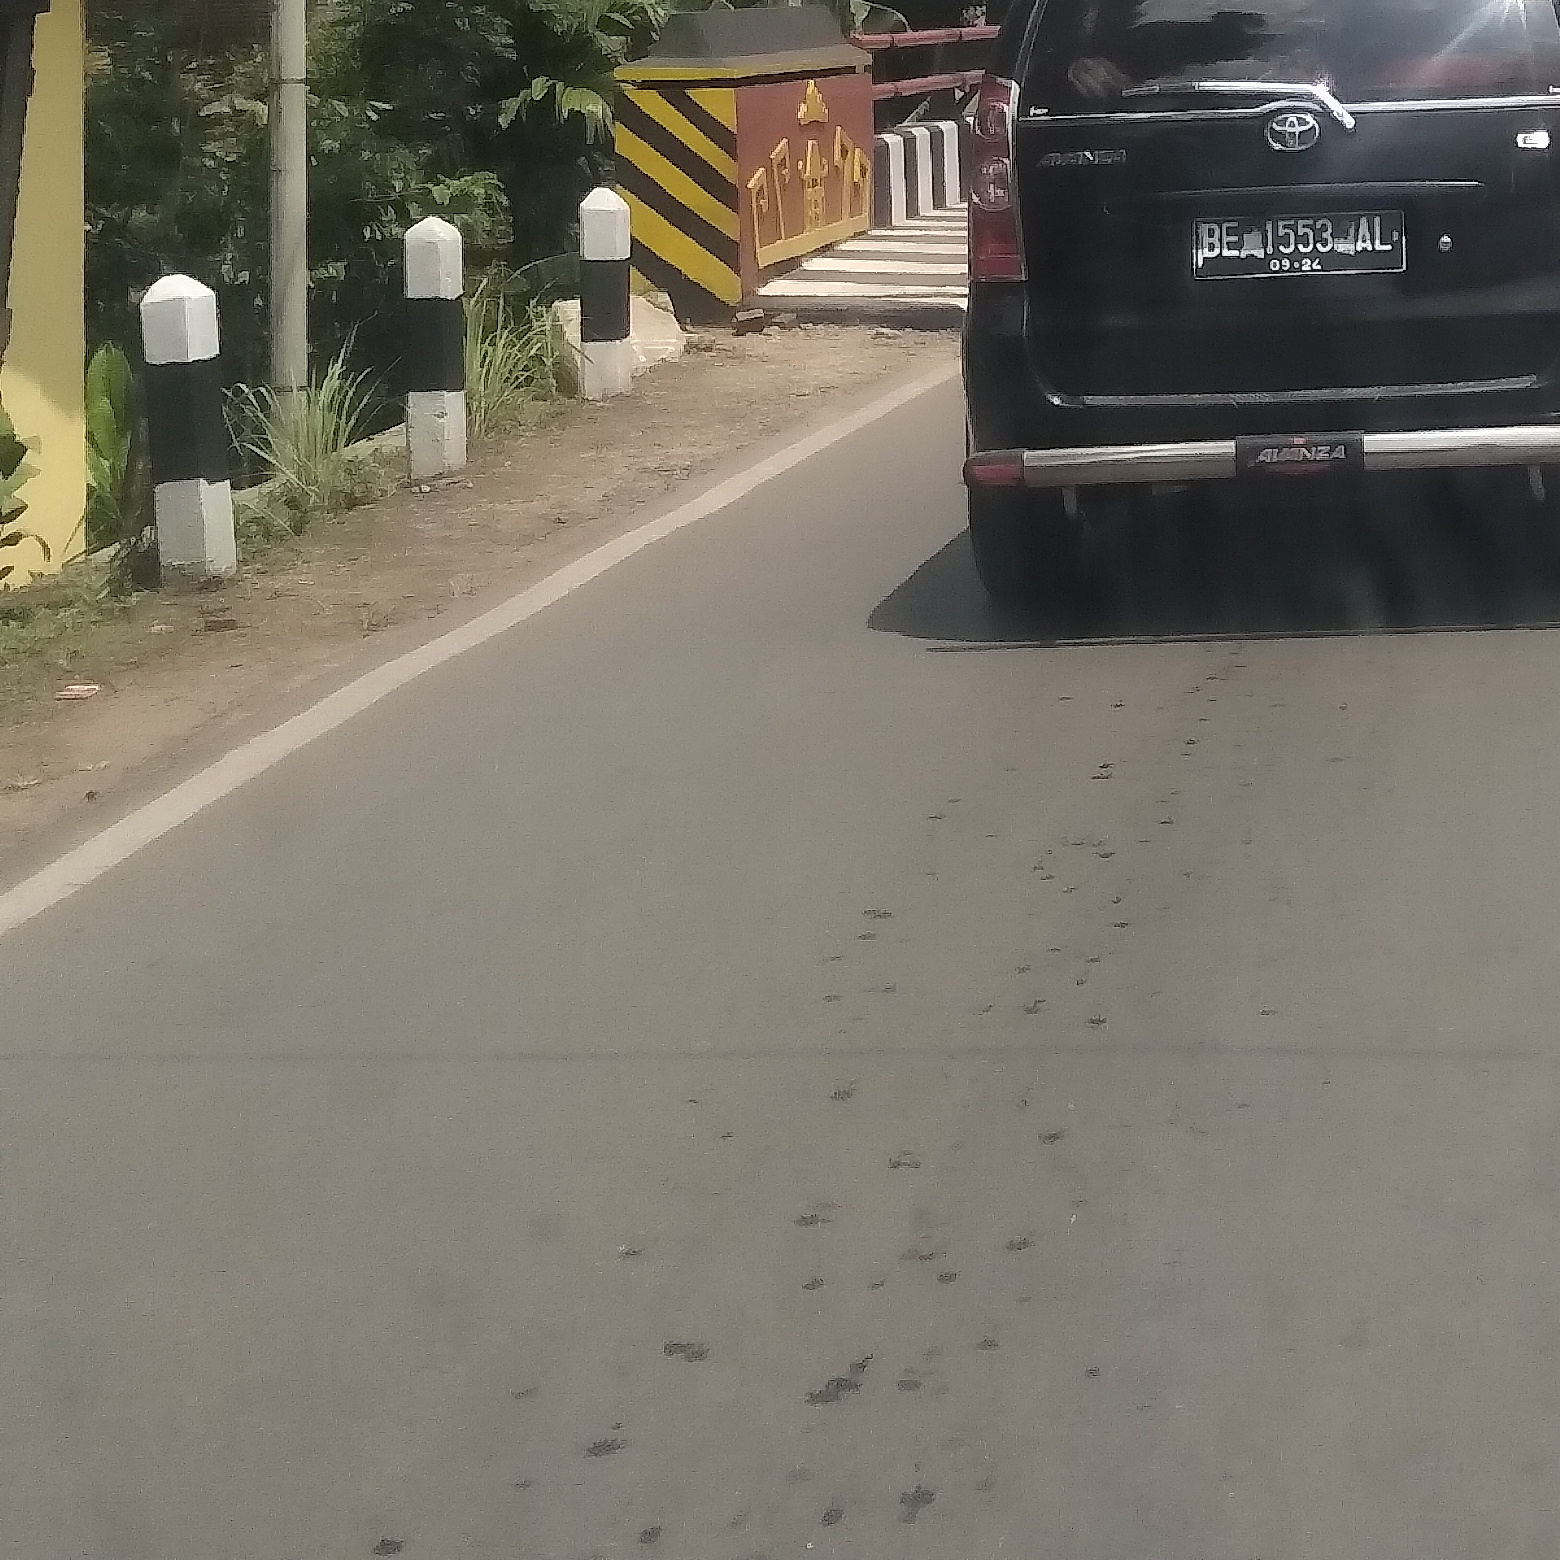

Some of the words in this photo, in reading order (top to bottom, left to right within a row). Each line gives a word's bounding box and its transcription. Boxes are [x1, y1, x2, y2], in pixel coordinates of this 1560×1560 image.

[1201, 221, 1240, 258] BE
[1265, 218, 1333, 254] 1553
[1356, 215, 1393, 252] AL
